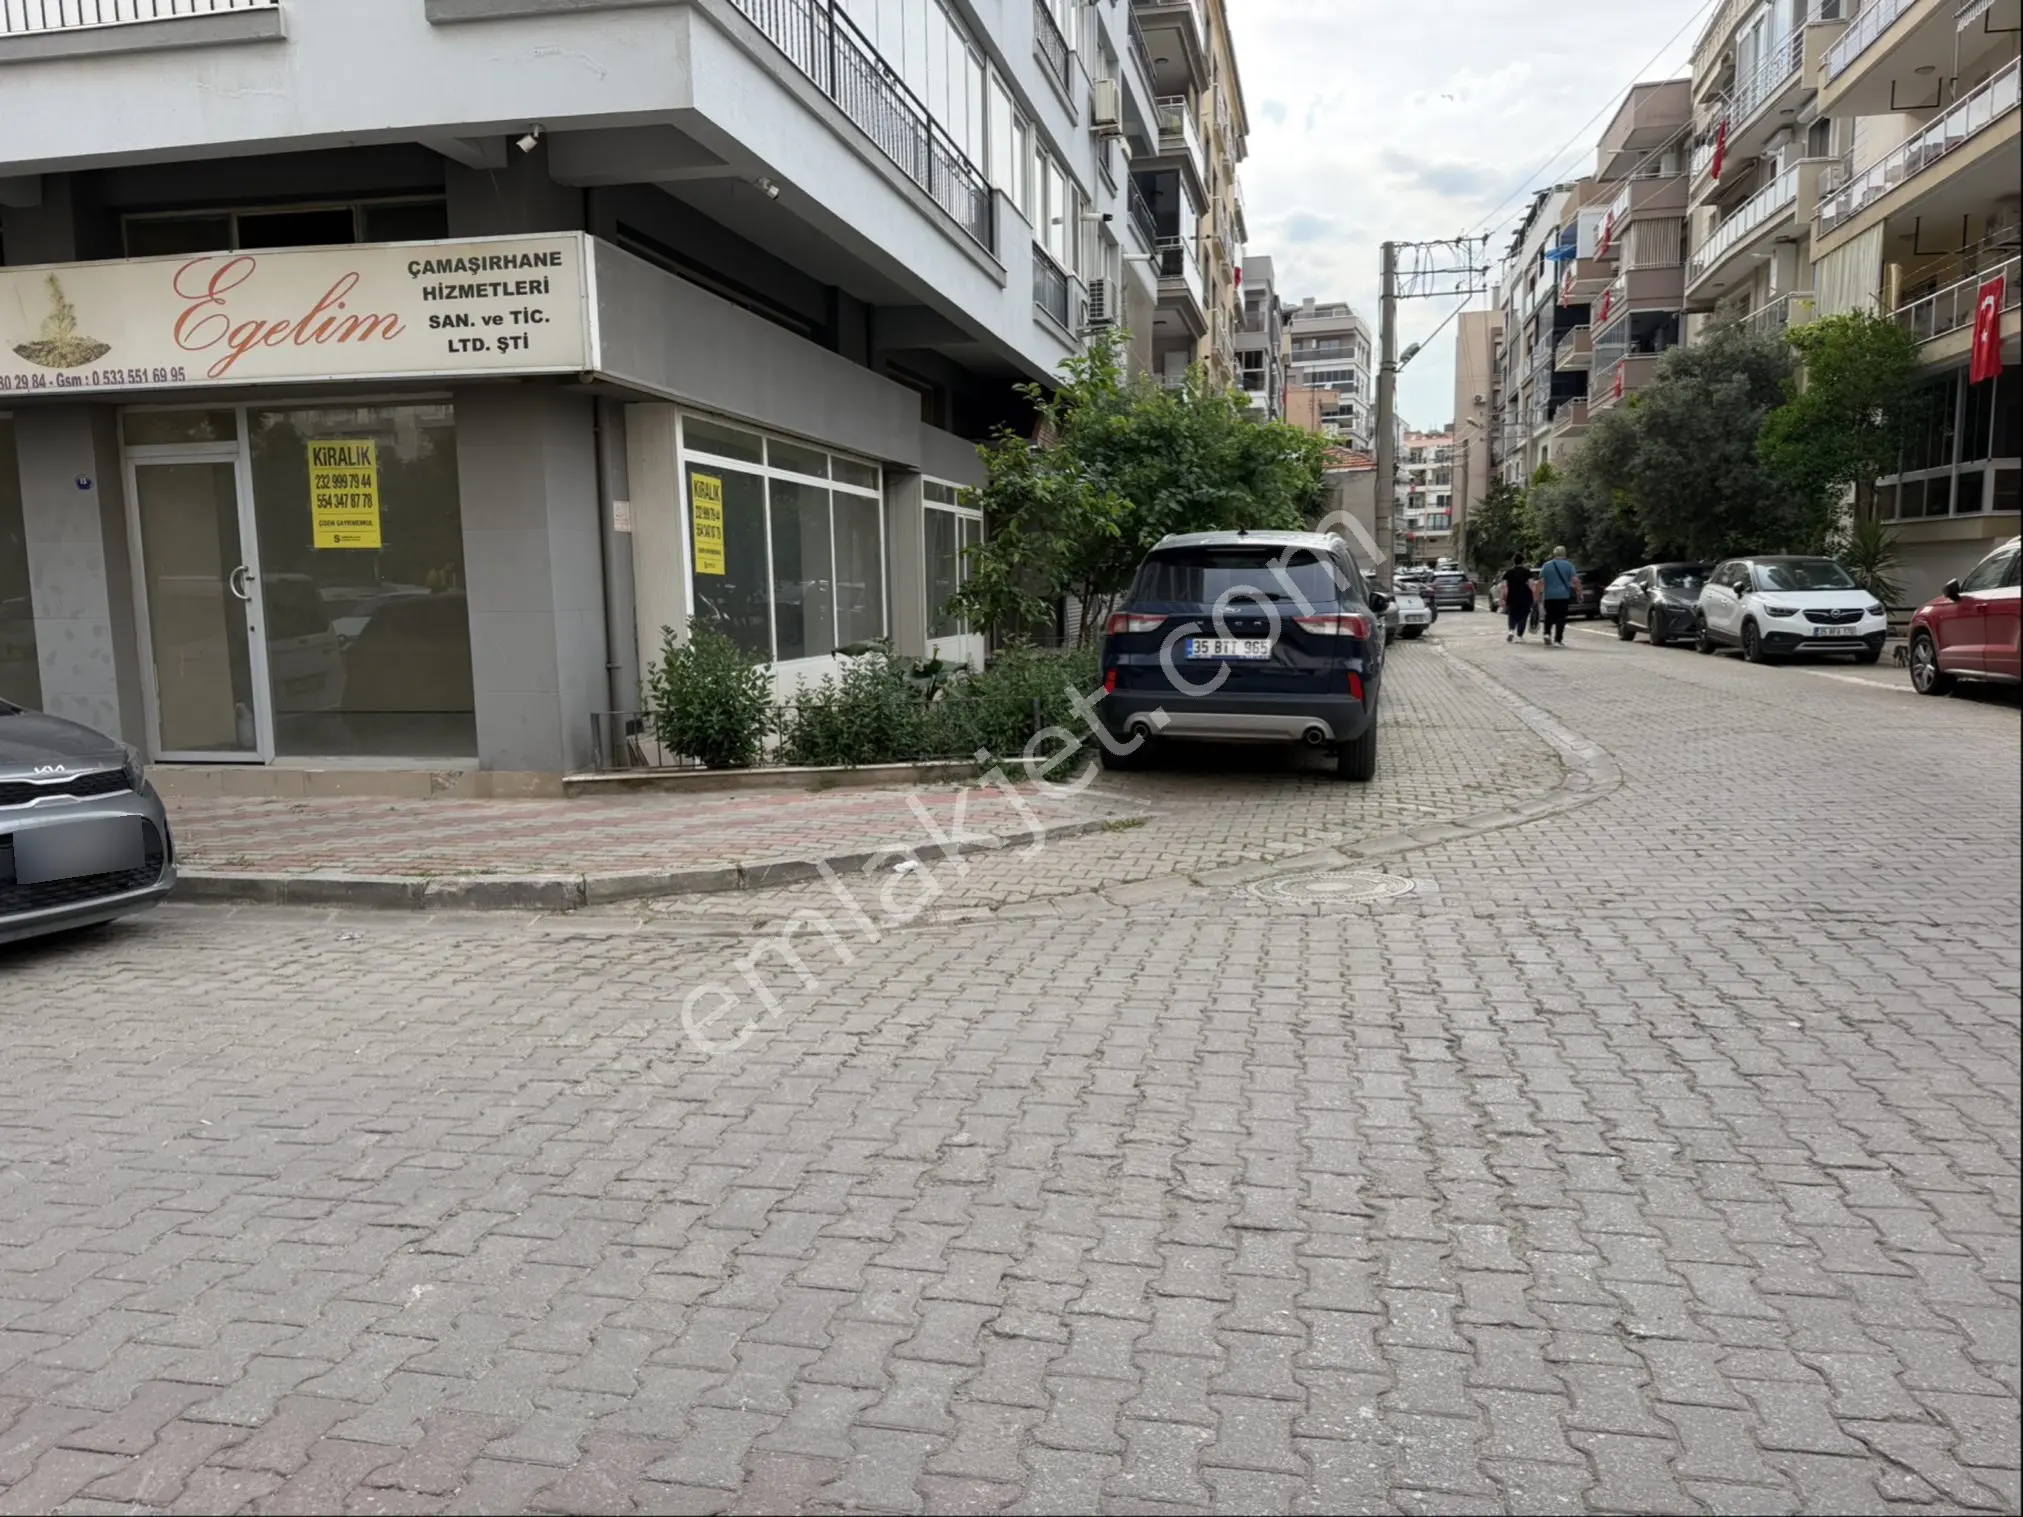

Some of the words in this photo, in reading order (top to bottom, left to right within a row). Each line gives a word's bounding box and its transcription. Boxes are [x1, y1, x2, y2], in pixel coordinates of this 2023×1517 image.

[408, 251, 563, 279] ÇAMAŞIRHANE
[423, 275, 550, 301] HİZMETLERİ
[173, 256, 407, 379] Egelim
[429, 313, 475, 329] SAN.
[481, 314, 504, 326] ve
[509, 306, 550, 325] TİC.
[448, 337, 490, 353] LTD.
[497, 332, 529, 354] ŞTİ
[15, 374, 29, 390] 29
[32, 373, 46, 389] 84
[56, 372, 82, 388] Gsm
[92, 371, 100, 386] 0
[103, 369, 125, 385] 533
[128, 368, 148, 384] 551
[152, 367, 167, 382] 69
[171, 366, 186, 382] 95
[315, 474, 331, 489] 232
[332, 473, 348, 489] 999
[349, 473, 360, 489] 79
[361, 473, 372, 488] 44
[317, 493, 332, 508] 554
[334, 493, 348, 508] 347
[350, 493, 360, 508] 87
[362, 493, 373, 508] 78
[1193, 640, 1209, 654] 35
